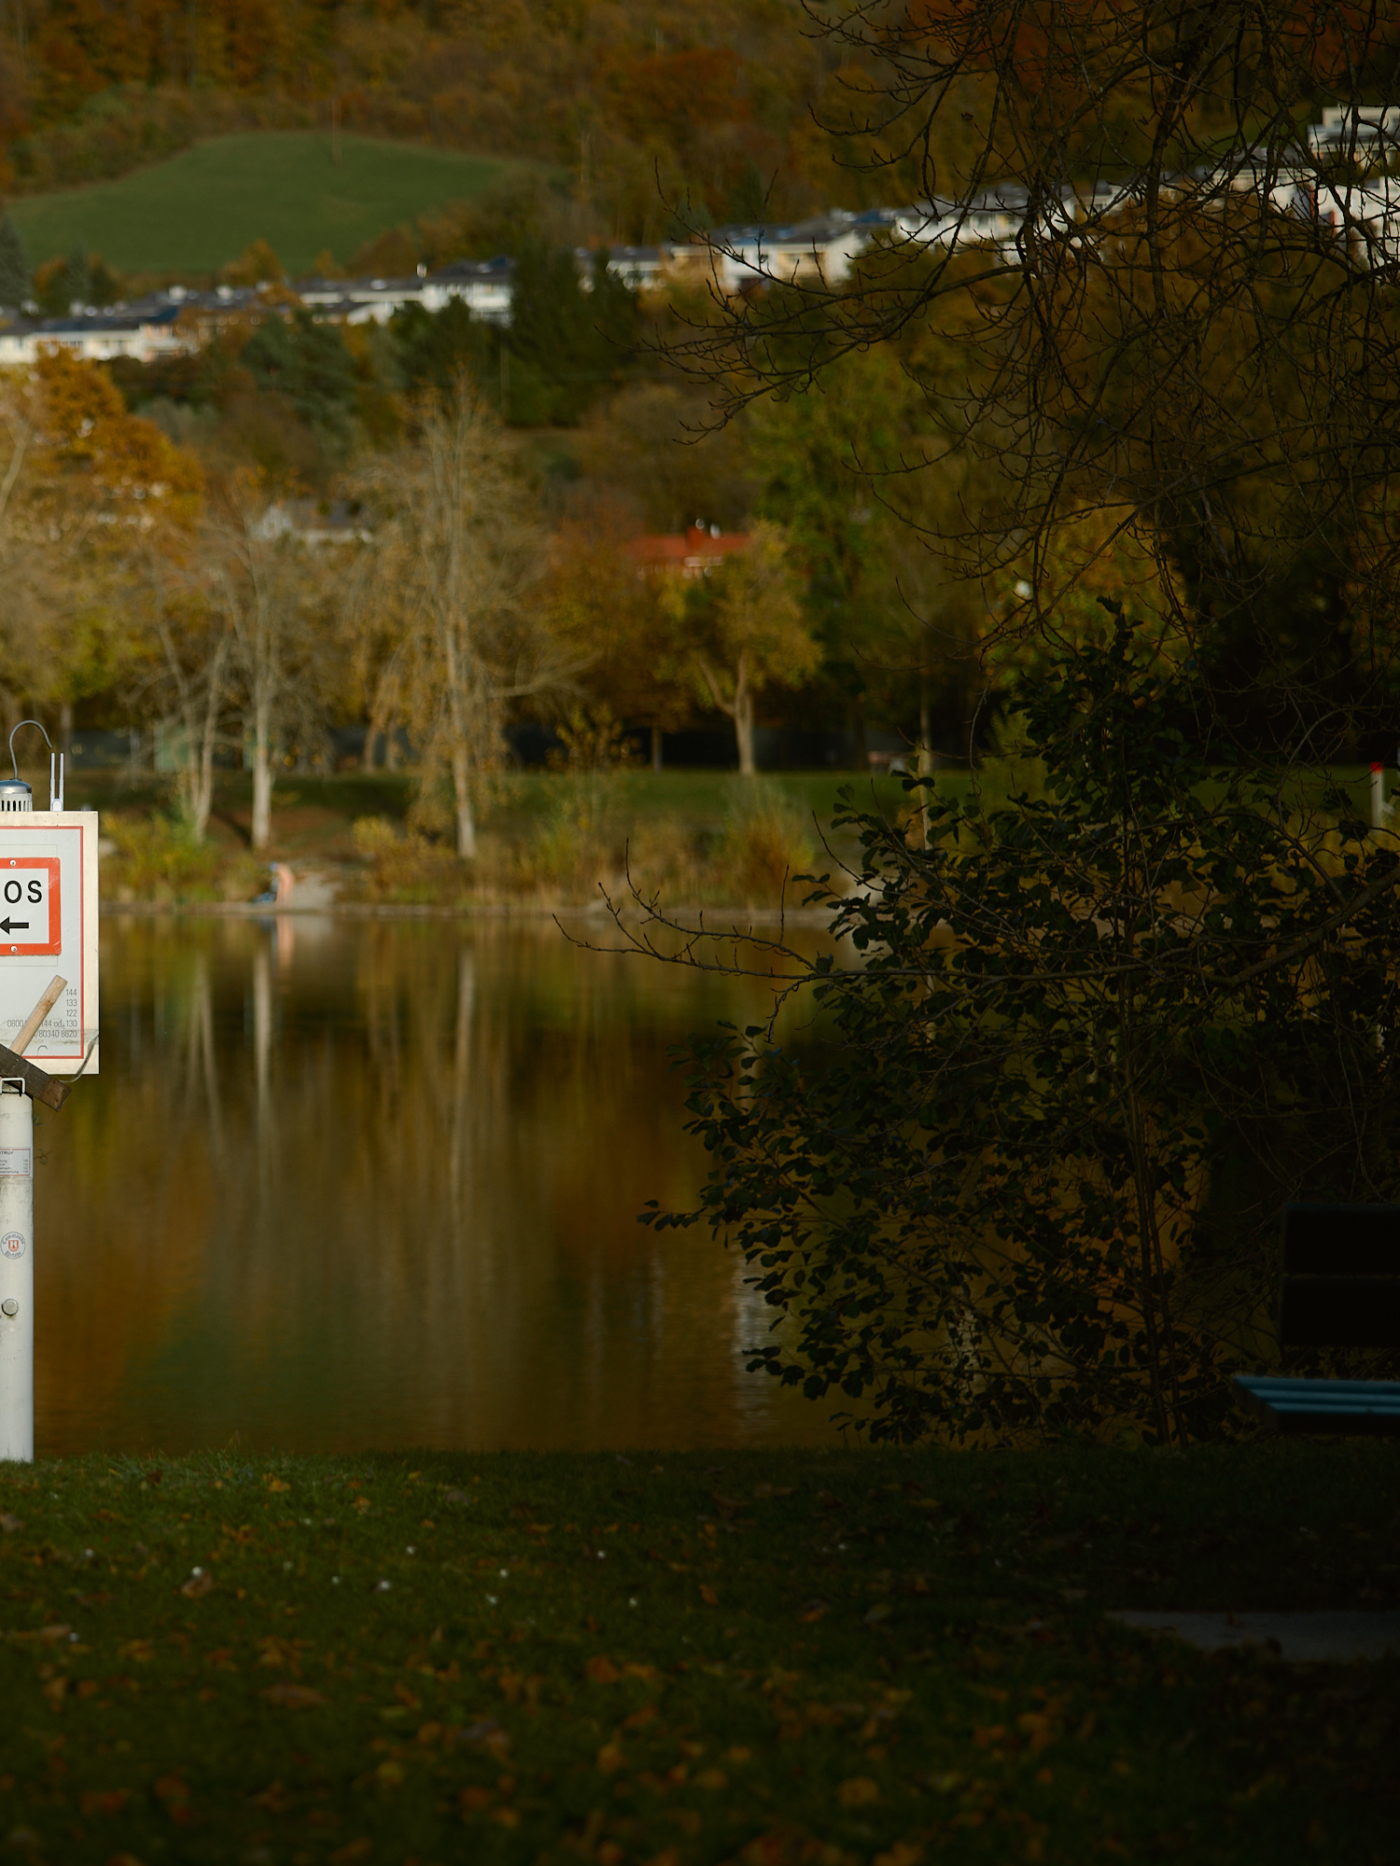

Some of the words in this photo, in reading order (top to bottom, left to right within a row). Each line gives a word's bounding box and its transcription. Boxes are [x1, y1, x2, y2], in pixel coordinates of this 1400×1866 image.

[66, 999, 77, 1007] 133
[66, 1009, 77, 1017] 122
[66, 1020, 77, 1028] 130
